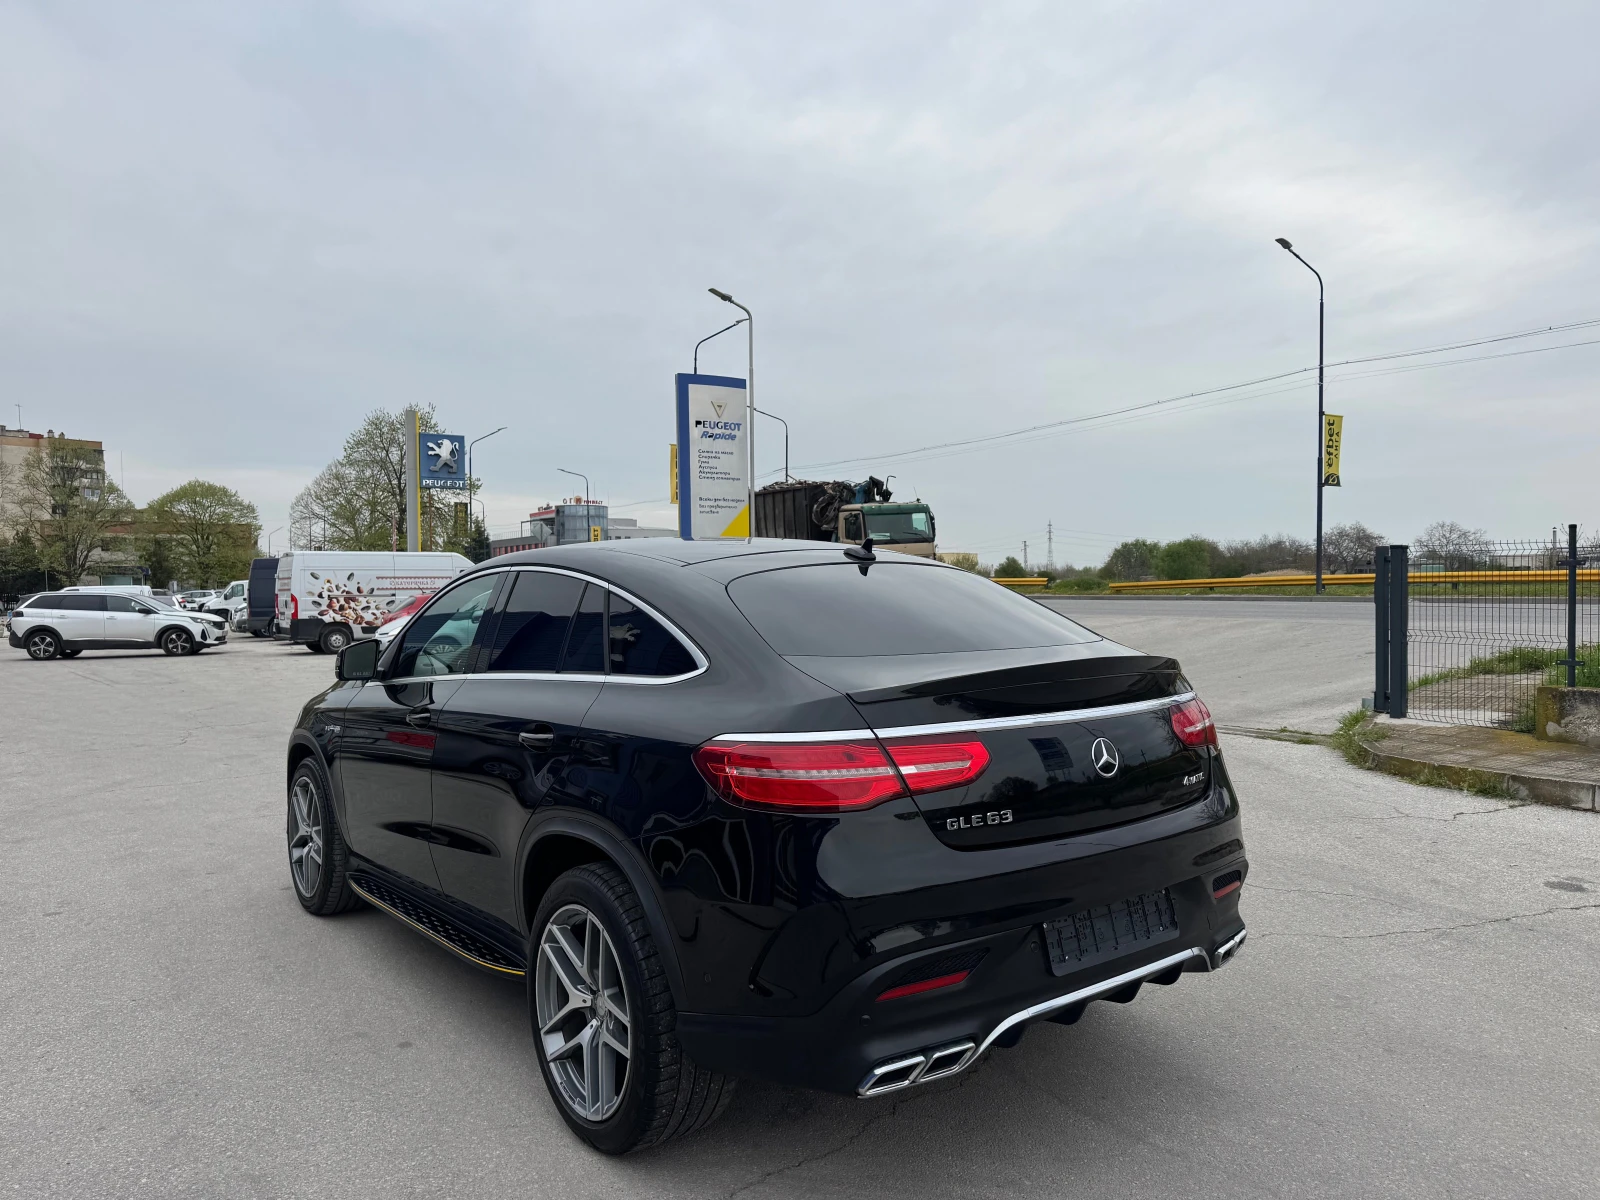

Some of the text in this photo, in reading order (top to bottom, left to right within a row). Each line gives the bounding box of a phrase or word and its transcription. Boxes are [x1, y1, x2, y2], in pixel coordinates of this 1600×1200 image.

[695, 420, 742, 431] PEUGEOT
[700, 431, 737, 441] Rapide
[1326, 418, 1335, 468] efbet
[422, 479, 464, 487] PEUGEOT
[946, 809, 1013, 831] GLE 63
